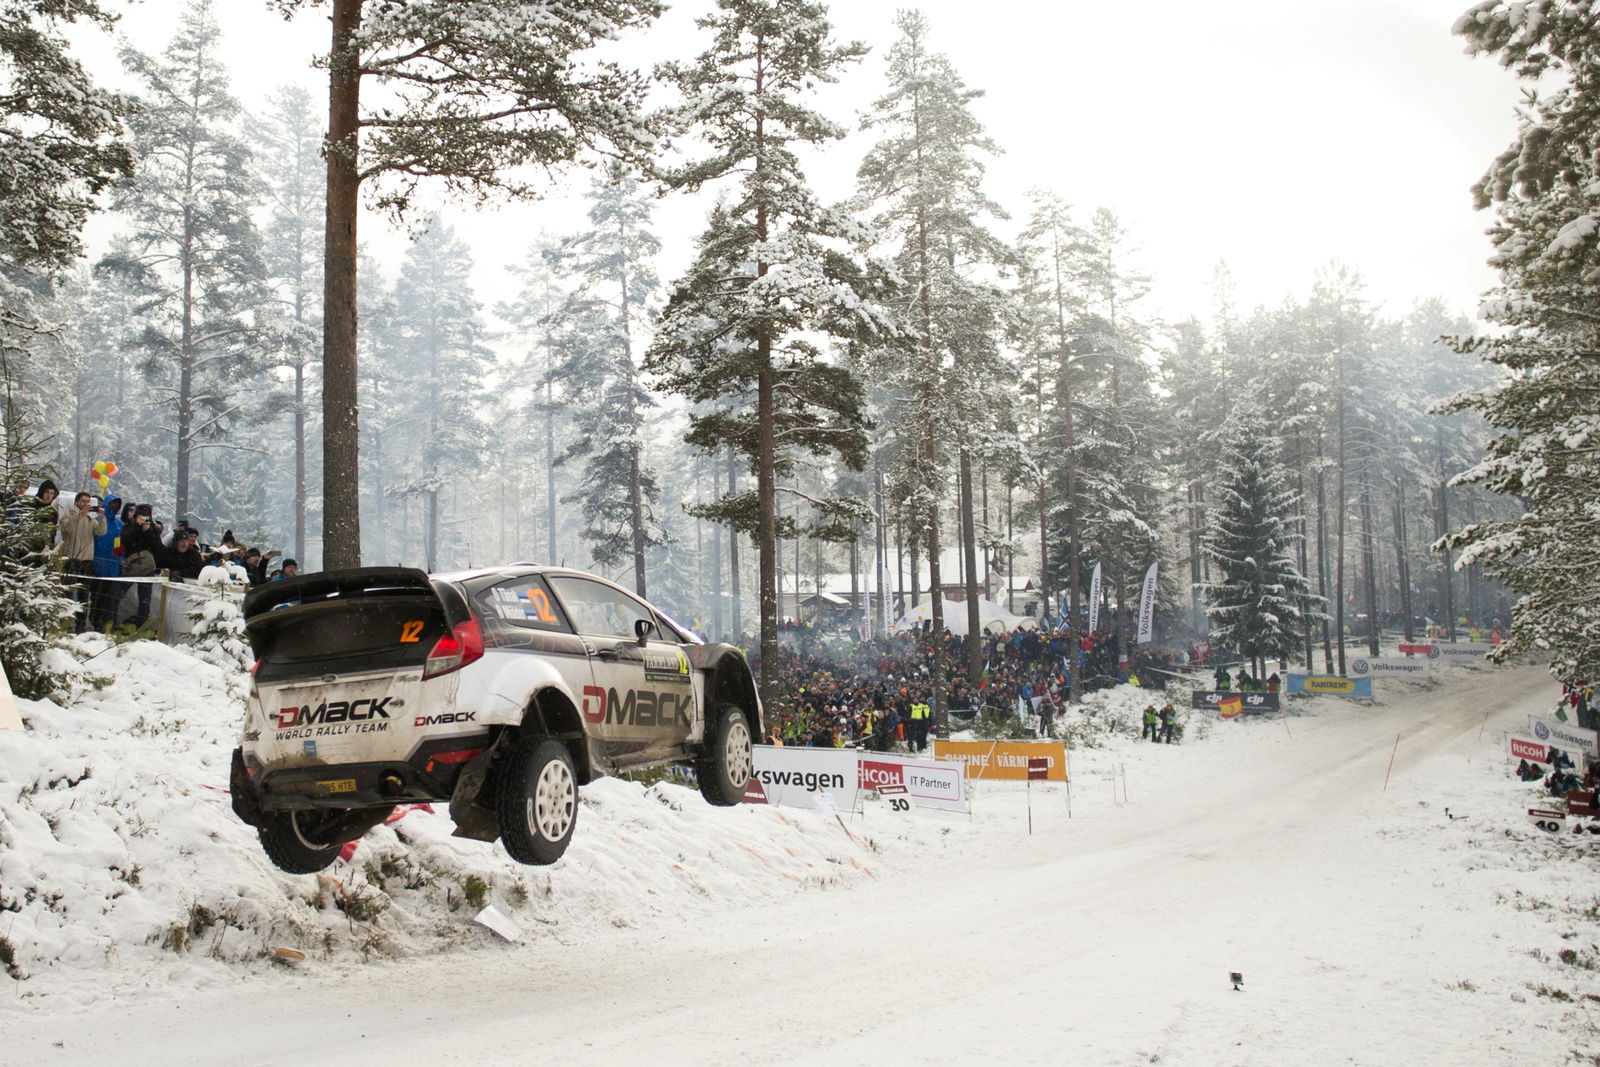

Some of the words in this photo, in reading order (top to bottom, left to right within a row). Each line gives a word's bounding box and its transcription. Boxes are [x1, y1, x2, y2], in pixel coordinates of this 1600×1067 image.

[527, 588, 558, 621] 12
[1140, 577, 1154, 635] Volkswagen
[400, 620, 425, 642] 12
[1442, 648, 1487, 656] Volkswagen
[1372, 663, 1423, 672] Volkswagen
[275, 728, 312, 741] WORLD
[316, 725, 350, 737] RALLY
[355, 722, 387, 733] TEAM
[1551, 728, 1593, 748] Volkswagen
[1512, 743, 1543, 758] RICOH
[910, 776, 919, 786] IT
[920, 777, 951, 790] Partner
[889, 798, 910, 812] 30
